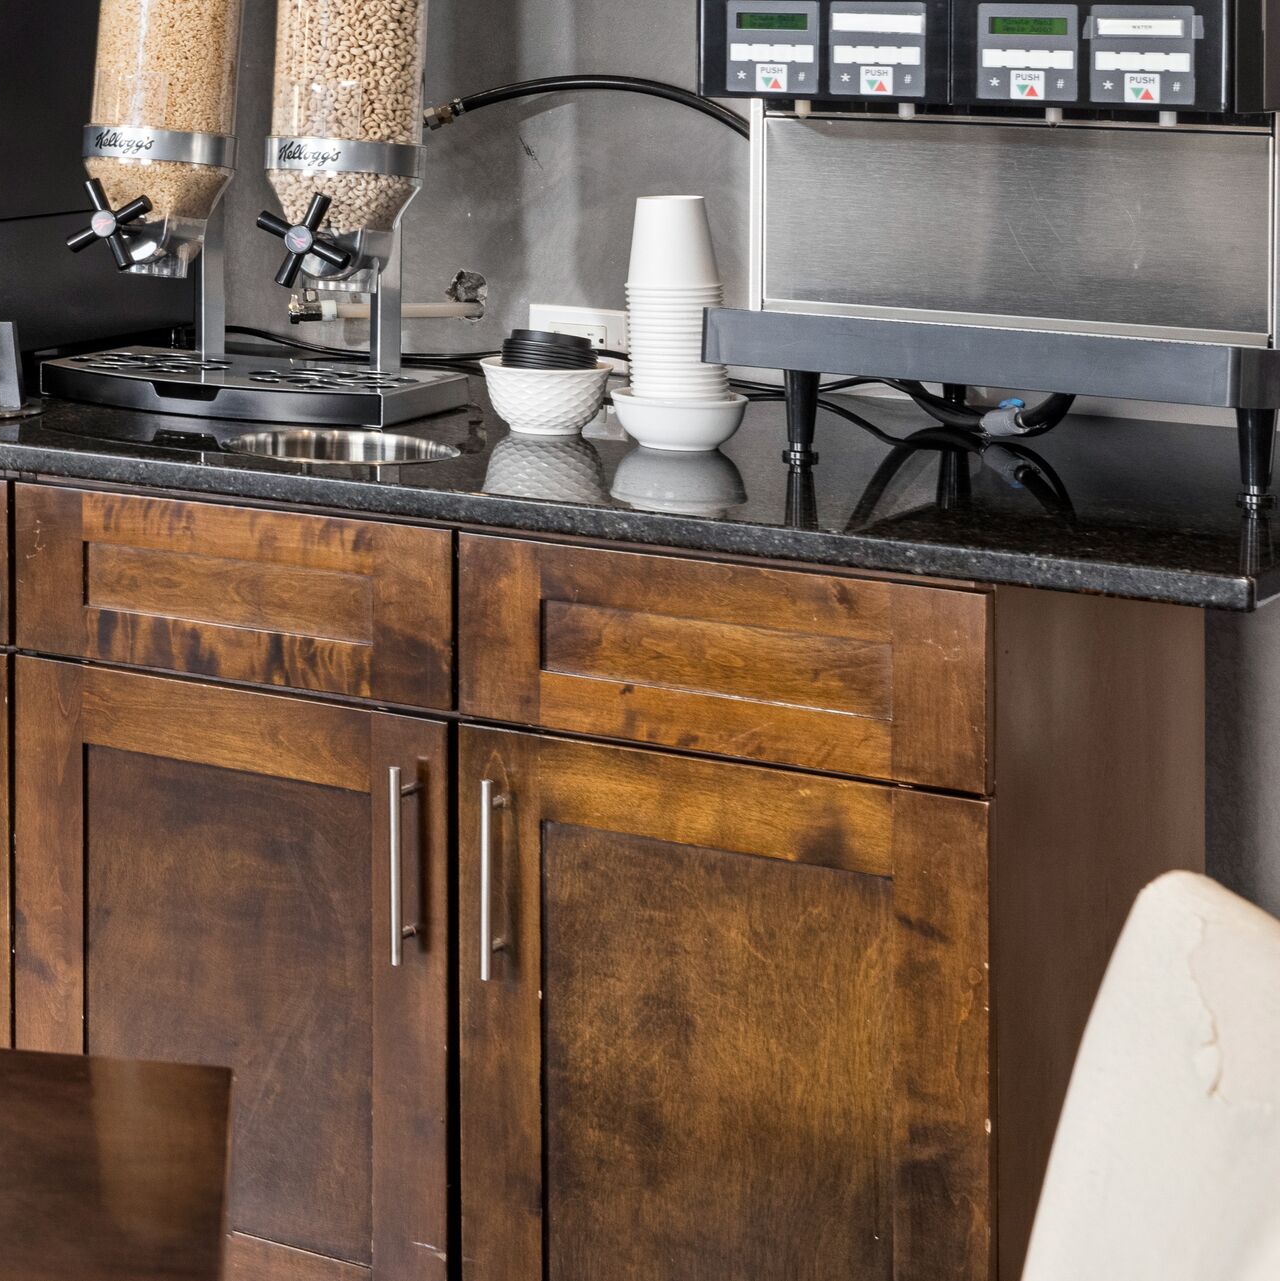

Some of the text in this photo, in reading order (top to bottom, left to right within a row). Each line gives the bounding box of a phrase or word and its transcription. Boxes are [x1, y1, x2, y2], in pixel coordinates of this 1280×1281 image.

[760, 66, 783, 74] PUSH
[1015, 73, 1040, 81] PUSH
[1129, 76, 1156, 84] PUSH
[95, 129, 155, 154] Kellogg's
[278, 141, 342, 167] Kellogg's
